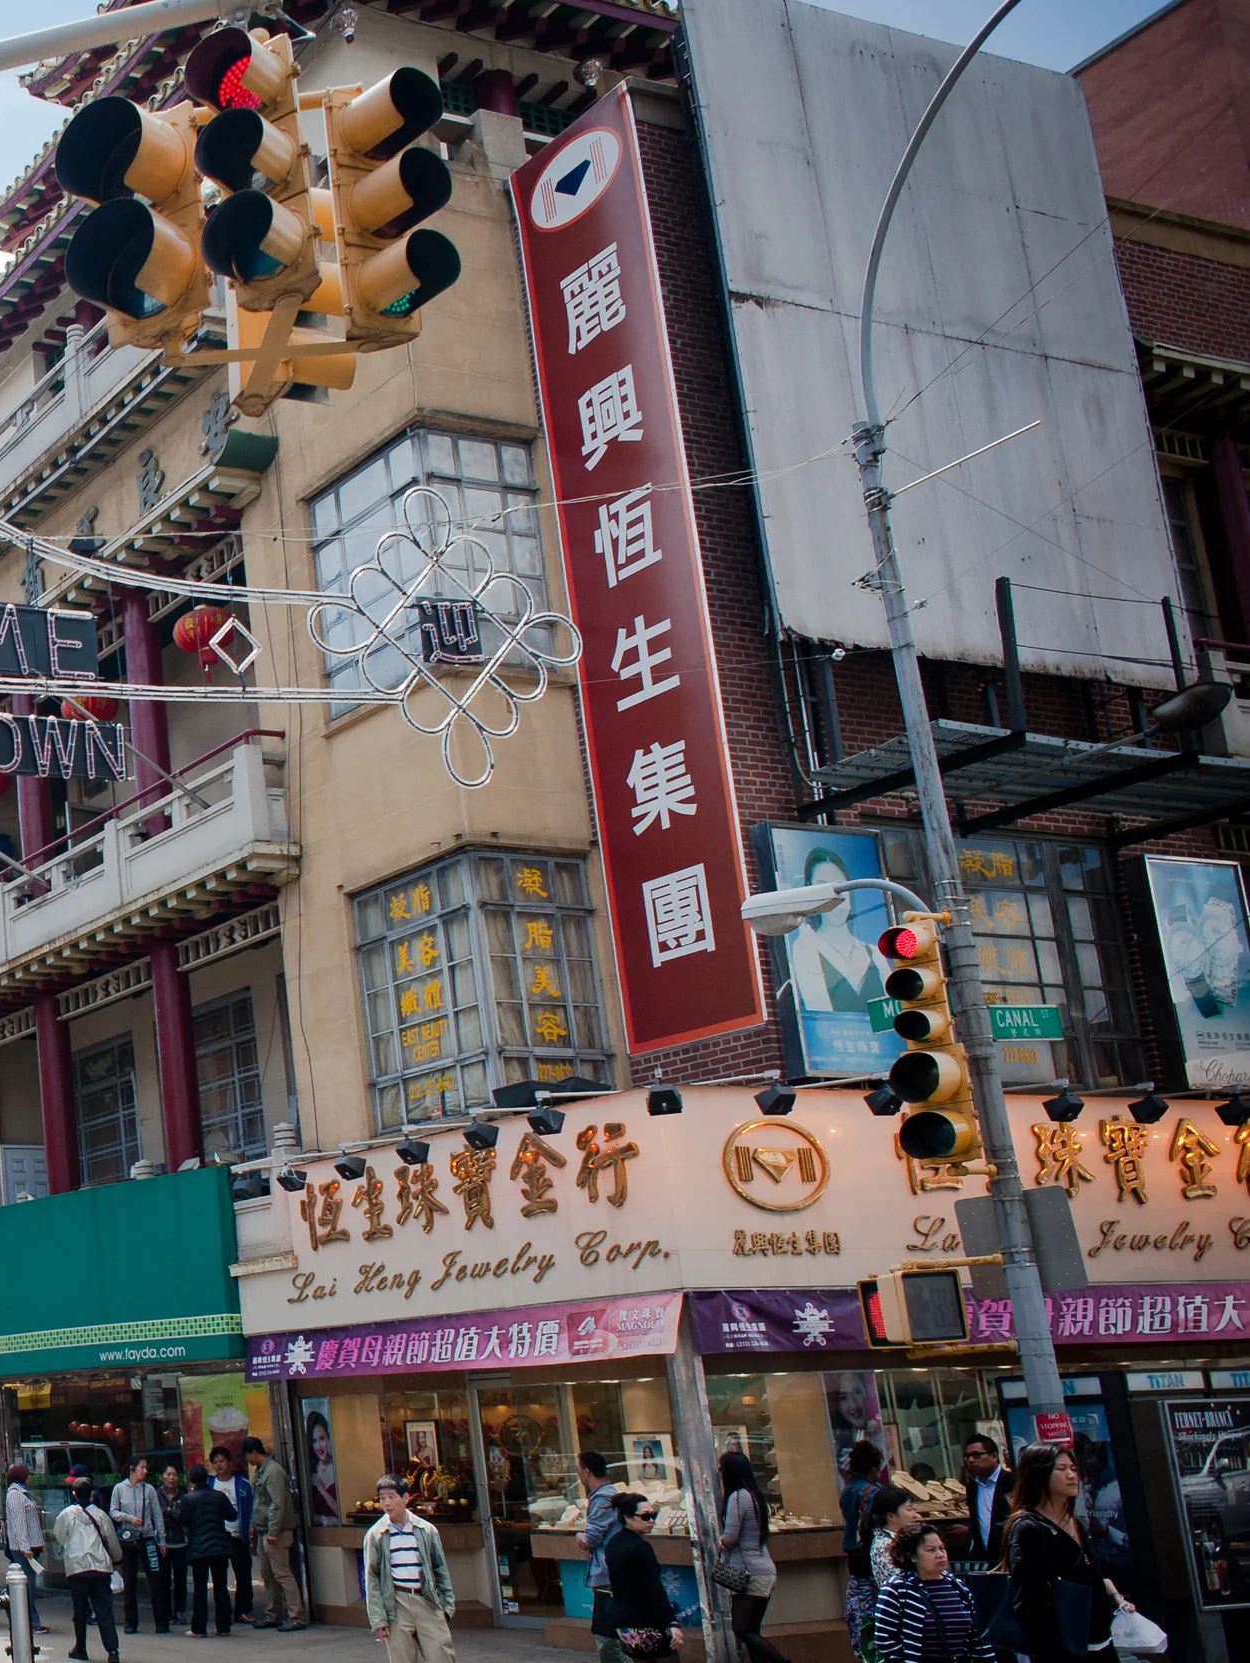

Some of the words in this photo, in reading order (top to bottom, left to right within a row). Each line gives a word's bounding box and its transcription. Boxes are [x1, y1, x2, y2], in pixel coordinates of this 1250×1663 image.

[421, 601, 484, 662] 迎
[969, 896, 1023, 928] 美容
[397, 935, 438, 975] 美容
[516, 867, 568, 1042] 凝脂美容
[402, 1028, 420, 1048] EAST
[422, 1018, 449, 1041] BEAUTY
[996, 1010, 1039, 1028] CANAL
[1041, 1009, 1049, 1019] ST
[413, 1041, 441, 1063] CENTER
[1200, 1058, 1250, 1084] Chopar
[906, 1214, 960, 1252] La
[1089, 1218, 1214, 1261] Jewelry
[287, 1271, 337, 1303] Lai
[353, 1261, 422, 1299] Heng
[430, 1241, 555, 1291] Jewelry
[964, 1294, 1247, 1339] 賀親節超值大
[99, 1345, 186, 1362] www.fayda.com
[314, 1319, 560, 1371] 慶賀母親節超值大特價
[1146, 1373, 1185, 1389] TITAN
[1230, 1372, 1250, 1387] TIT
[1178, 1431, 1216, 1442] Shockingly
